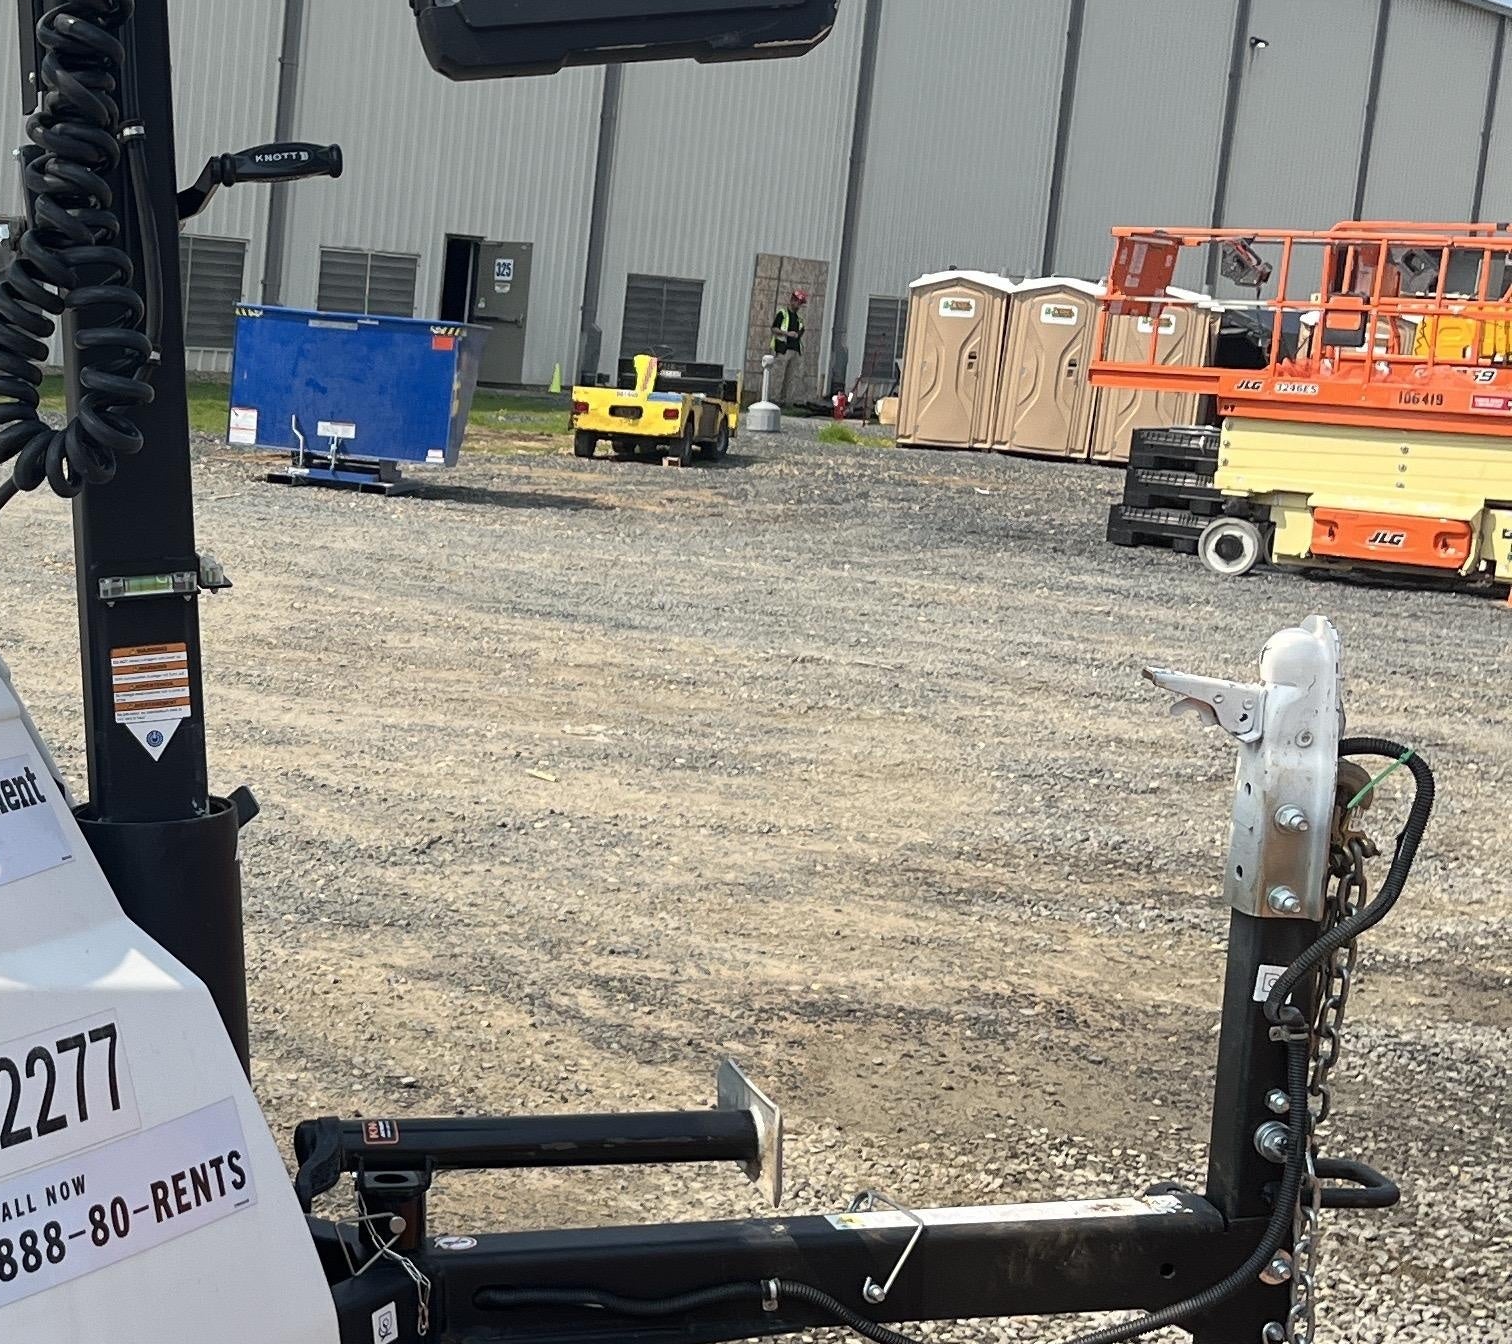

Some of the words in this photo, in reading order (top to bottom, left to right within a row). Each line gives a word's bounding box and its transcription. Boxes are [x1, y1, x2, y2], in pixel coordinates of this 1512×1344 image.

[496, 261, 512, 277] 325
[1237, 379, 1262, 391] JLG
[1398, 390, 1444, 406] 106419
[1369, 531, 1405, 546] JLG
[45, 1175, 87, 1207] NOW
